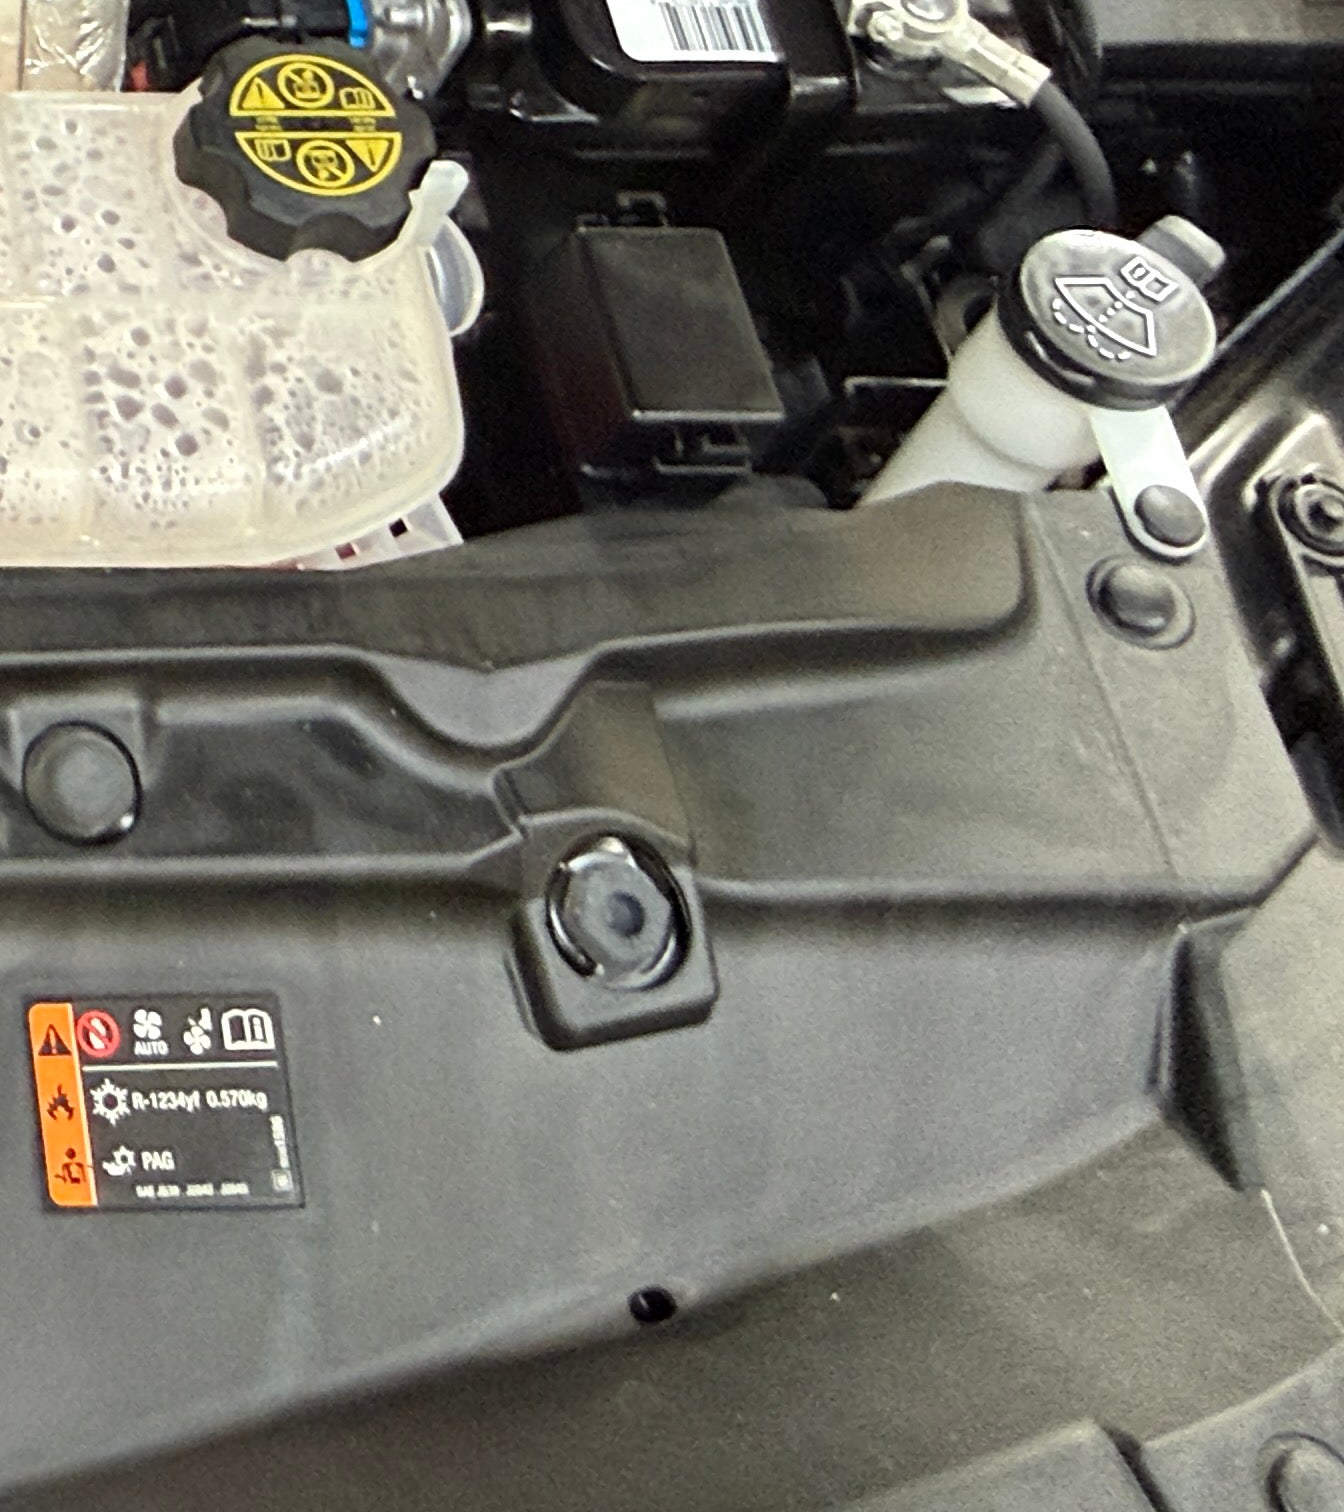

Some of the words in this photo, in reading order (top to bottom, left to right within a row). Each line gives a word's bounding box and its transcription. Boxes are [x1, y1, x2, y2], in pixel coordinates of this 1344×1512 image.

[134, 1040, 169, 1057] AUTO
[131, 1091, 200, 1113] R-1234yf
[206, 1090, 268, 1113] 0.570kg
[141, 1150, 175, 1171] PAG
